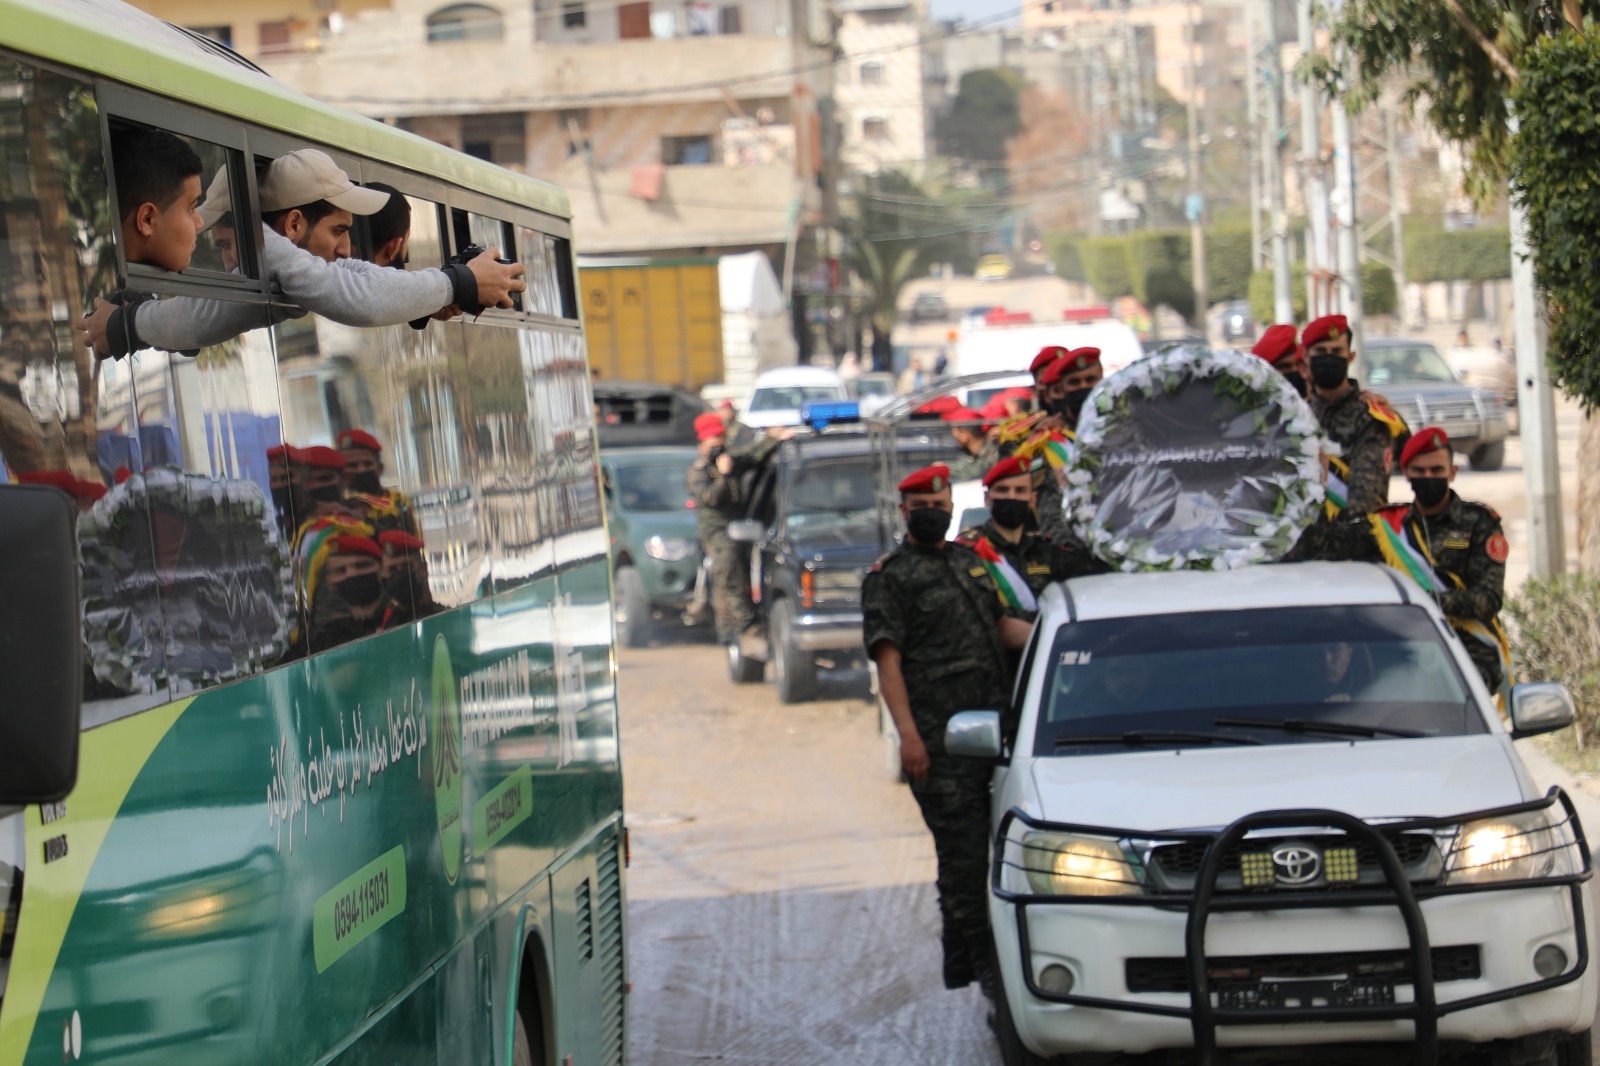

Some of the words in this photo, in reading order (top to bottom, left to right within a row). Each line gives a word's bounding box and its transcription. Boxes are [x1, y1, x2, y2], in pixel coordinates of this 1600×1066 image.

[366, 725, 388, 787] محمد
[403, 676, 427, 780] شركة
[334, 867, 390, 942] 0594-115031
